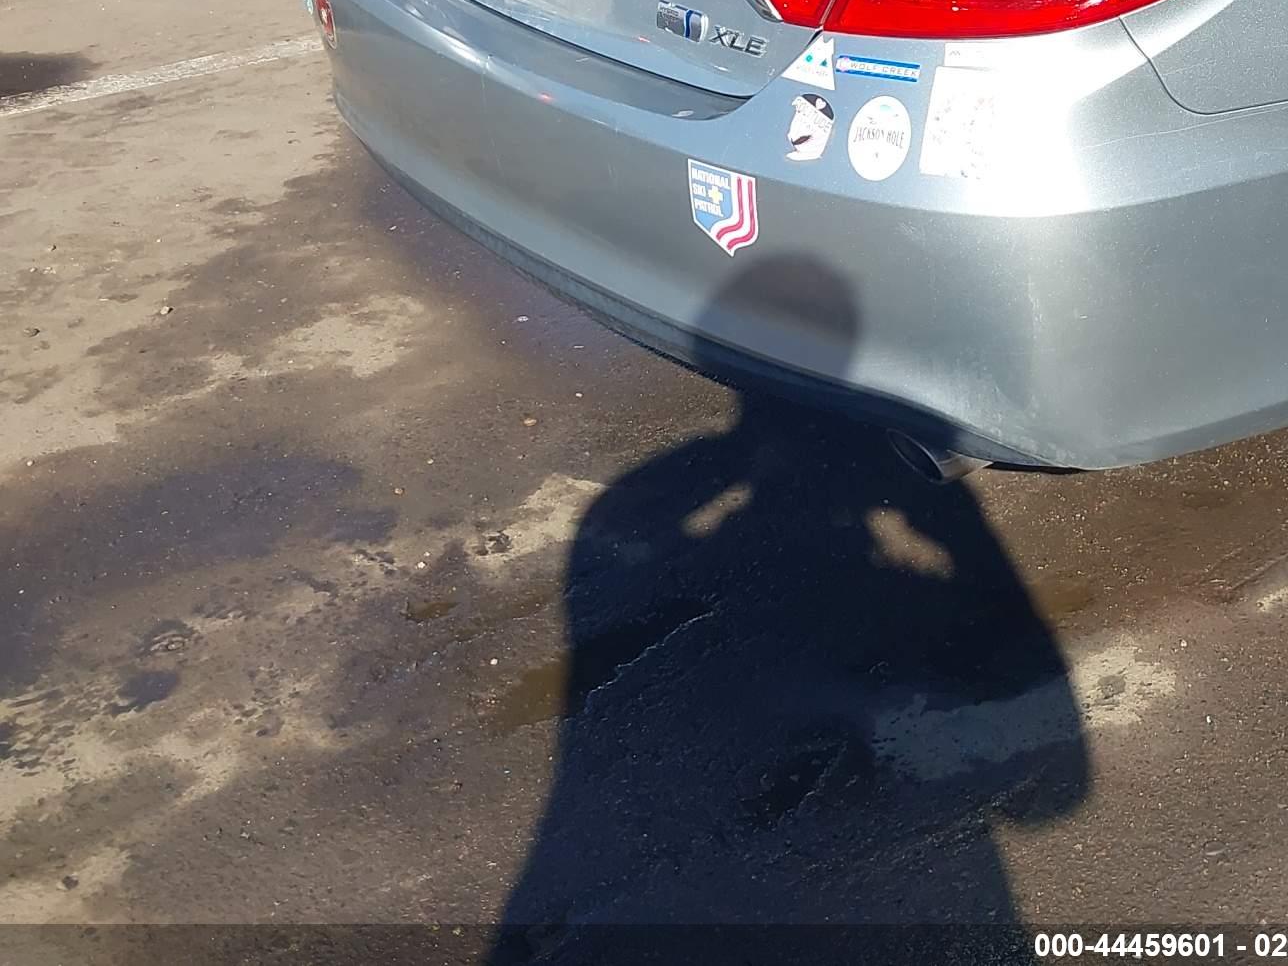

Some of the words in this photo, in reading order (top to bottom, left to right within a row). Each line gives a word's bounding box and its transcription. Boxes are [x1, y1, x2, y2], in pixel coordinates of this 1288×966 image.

[708, 24, 769, 58] XLE
[850, 61, 878, 71] WOLF
[882, 65, 917, 76] CREEK
[853, 125, 884, 143] JACKSON
[886, 129, 905, 150] HOLE
[691, 167, 730, 190] NATIONAL
[692, 183, 706, 197] SKI
[694, 198, 724, 217] PATROL
